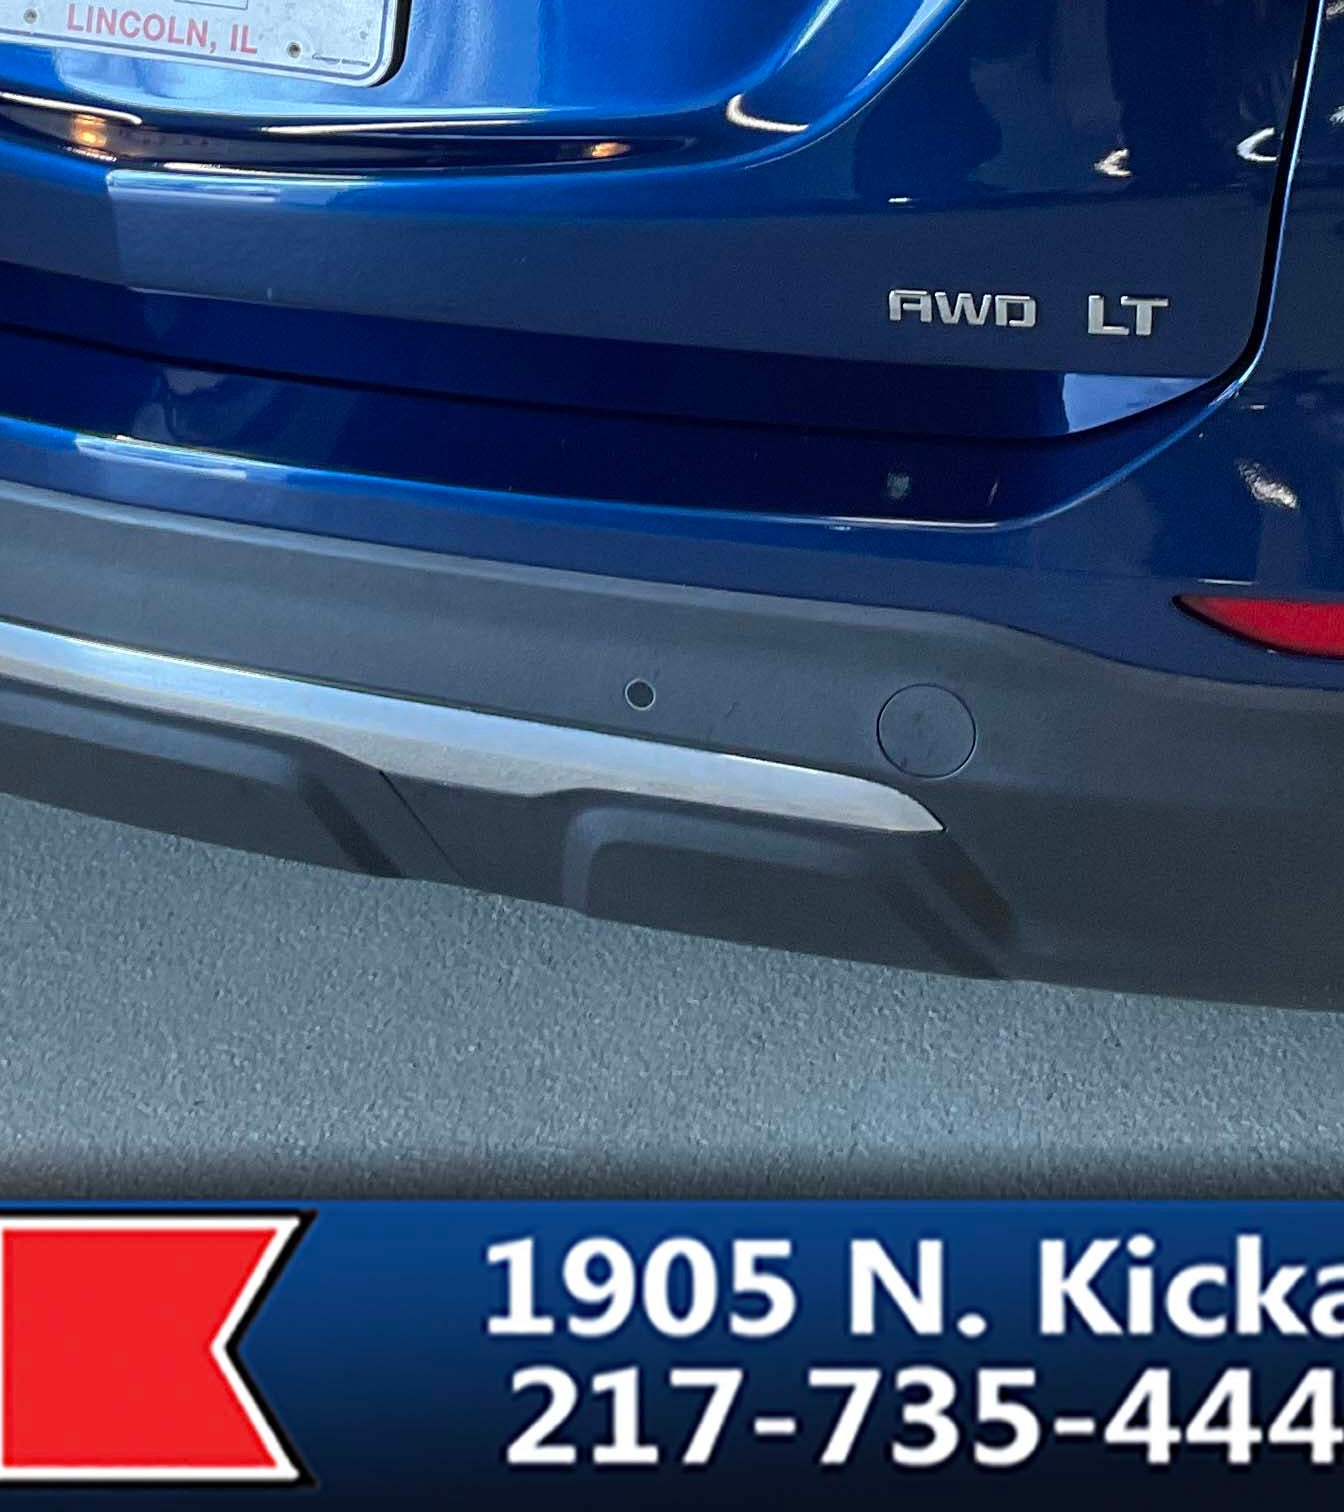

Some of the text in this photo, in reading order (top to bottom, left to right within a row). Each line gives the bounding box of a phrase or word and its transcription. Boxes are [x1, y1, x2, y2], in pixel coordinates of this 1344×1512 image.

[66, 2, 258, 55] LINCOLN, IL
[889, 289, 1037, 327] AWD
[1087, 295, 1169, 335] LT
